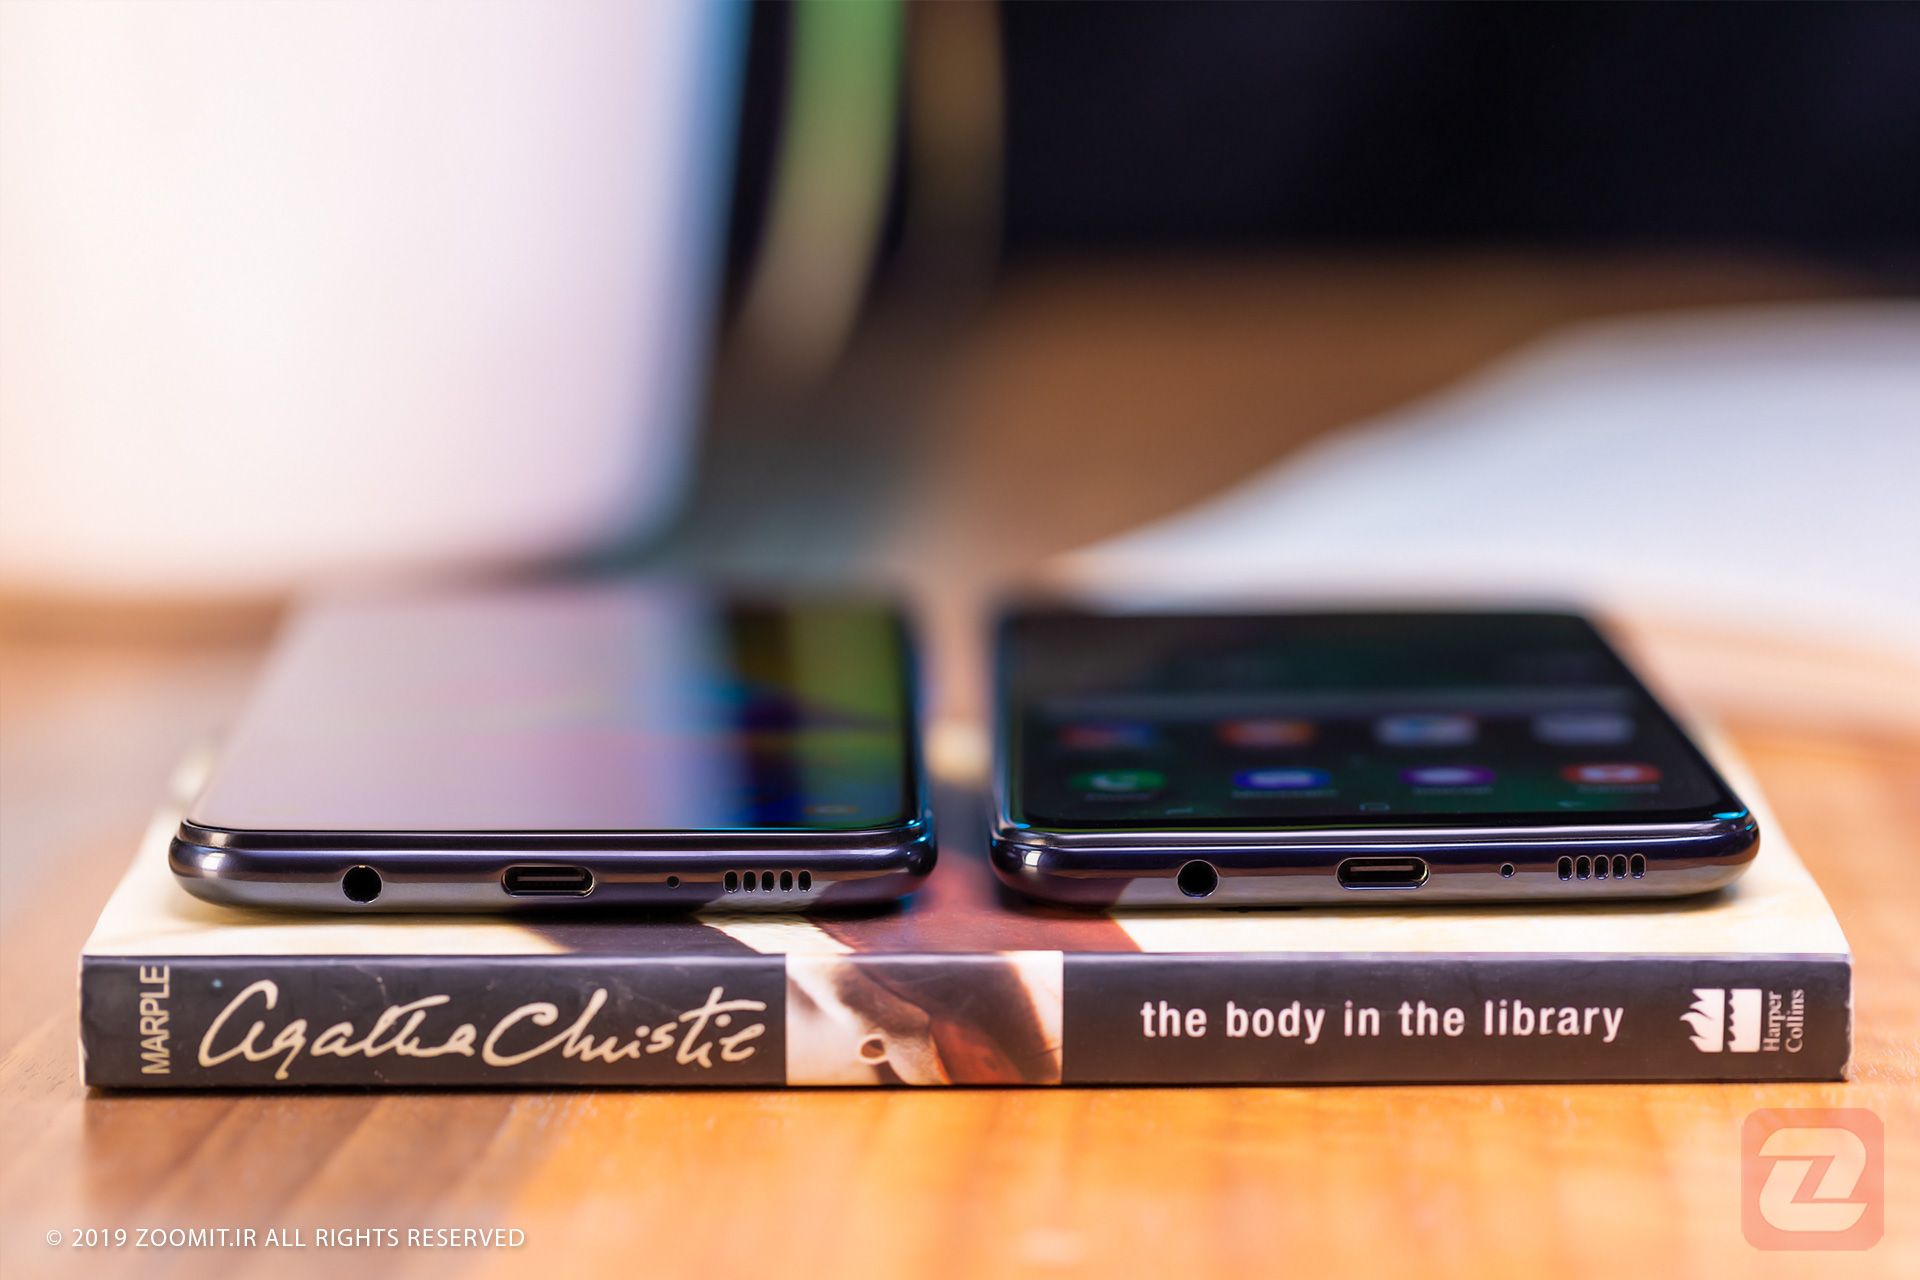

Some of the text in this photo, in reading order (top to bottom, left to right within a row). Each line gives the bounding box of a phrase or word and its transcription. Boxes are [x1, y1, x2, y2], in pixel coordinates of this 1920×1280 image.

[140, 964, 171, 1074] MARPLE
[481, 987, 768, 1069] Christie
[1141, 1000, 1624, 1045] the body in the library
[1762, 990, 1786, 1052] Harper
[1785, 989, 1805, 1053] Collins
